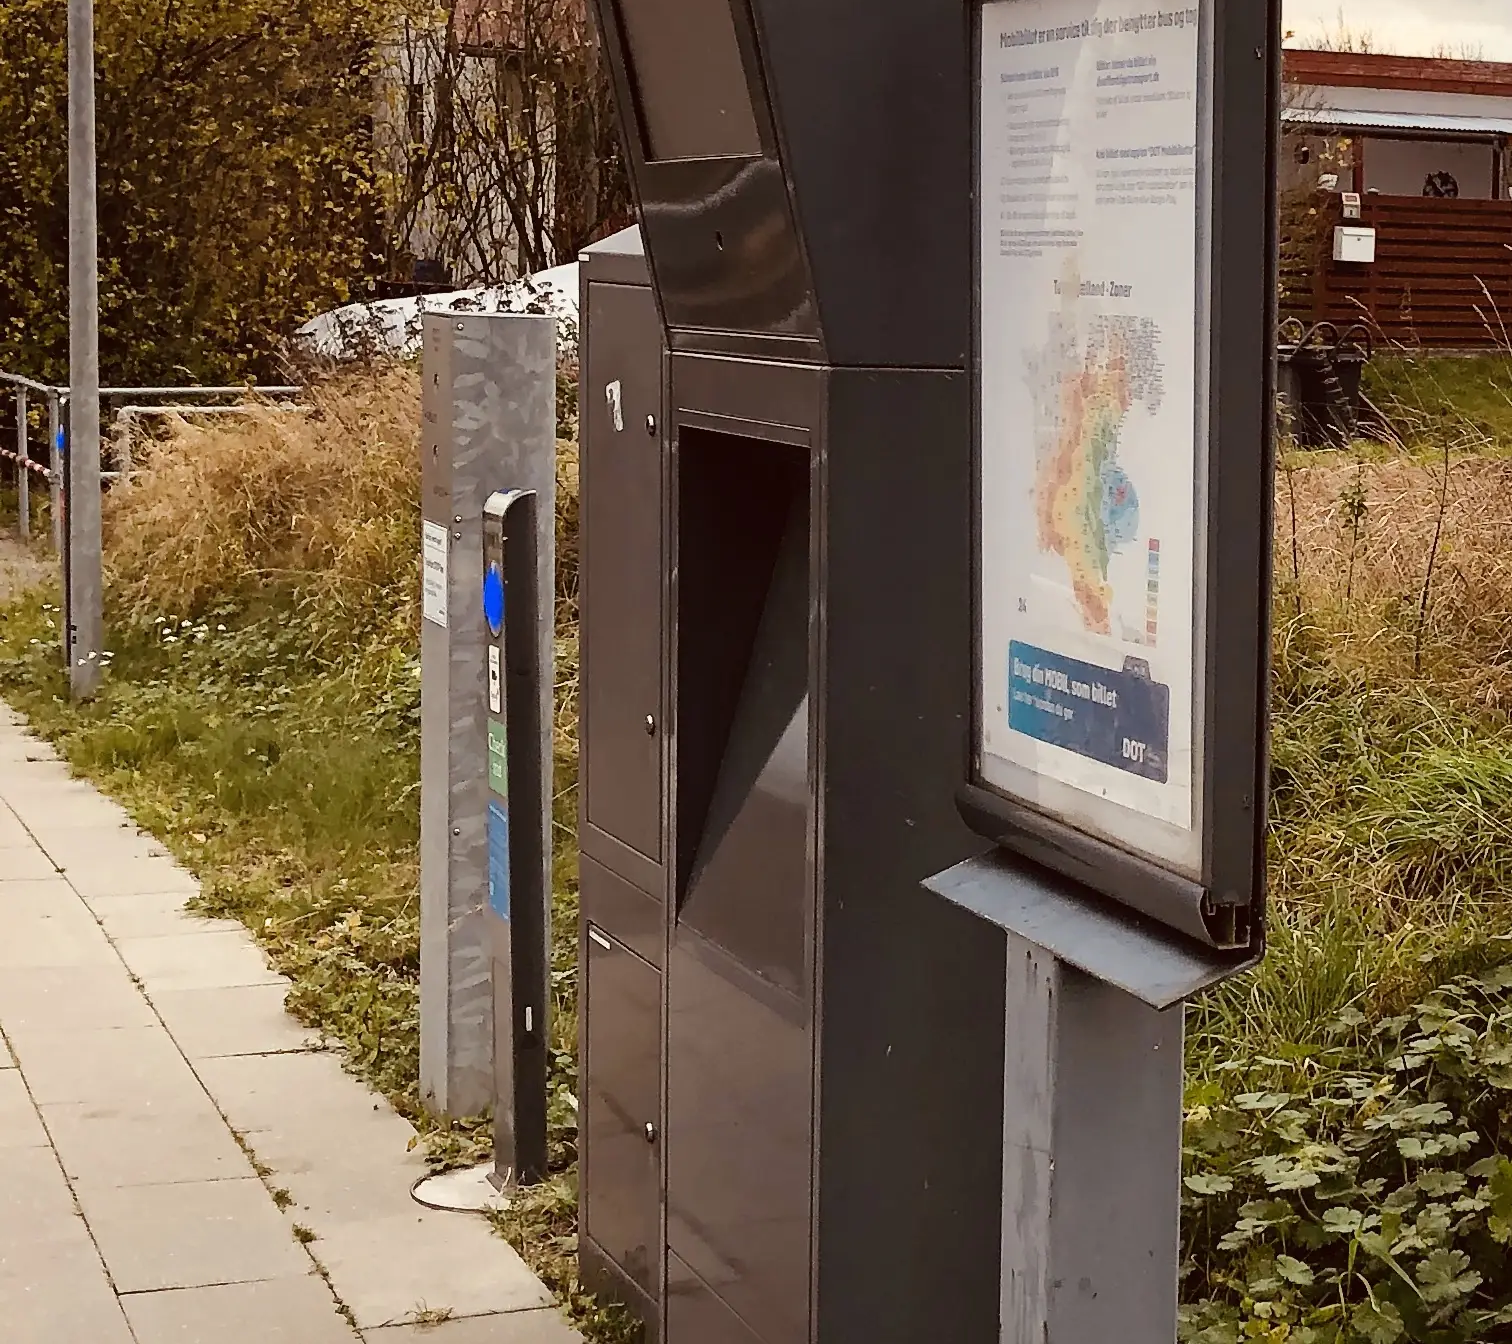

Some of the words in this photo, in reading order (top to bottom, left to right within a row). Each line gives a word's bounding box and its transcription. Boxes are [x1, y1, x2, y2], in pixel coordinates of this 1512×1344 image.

[1157, 10, 1173, 27] bus
[1174, 10, 1184, 28] og
[1109, 281, 1133, 297] Zoner
[1071, 681, 1090, 700] som
[1091, 682, 1117, 708] billet
[1122, 737, 1146, 763] DOT
